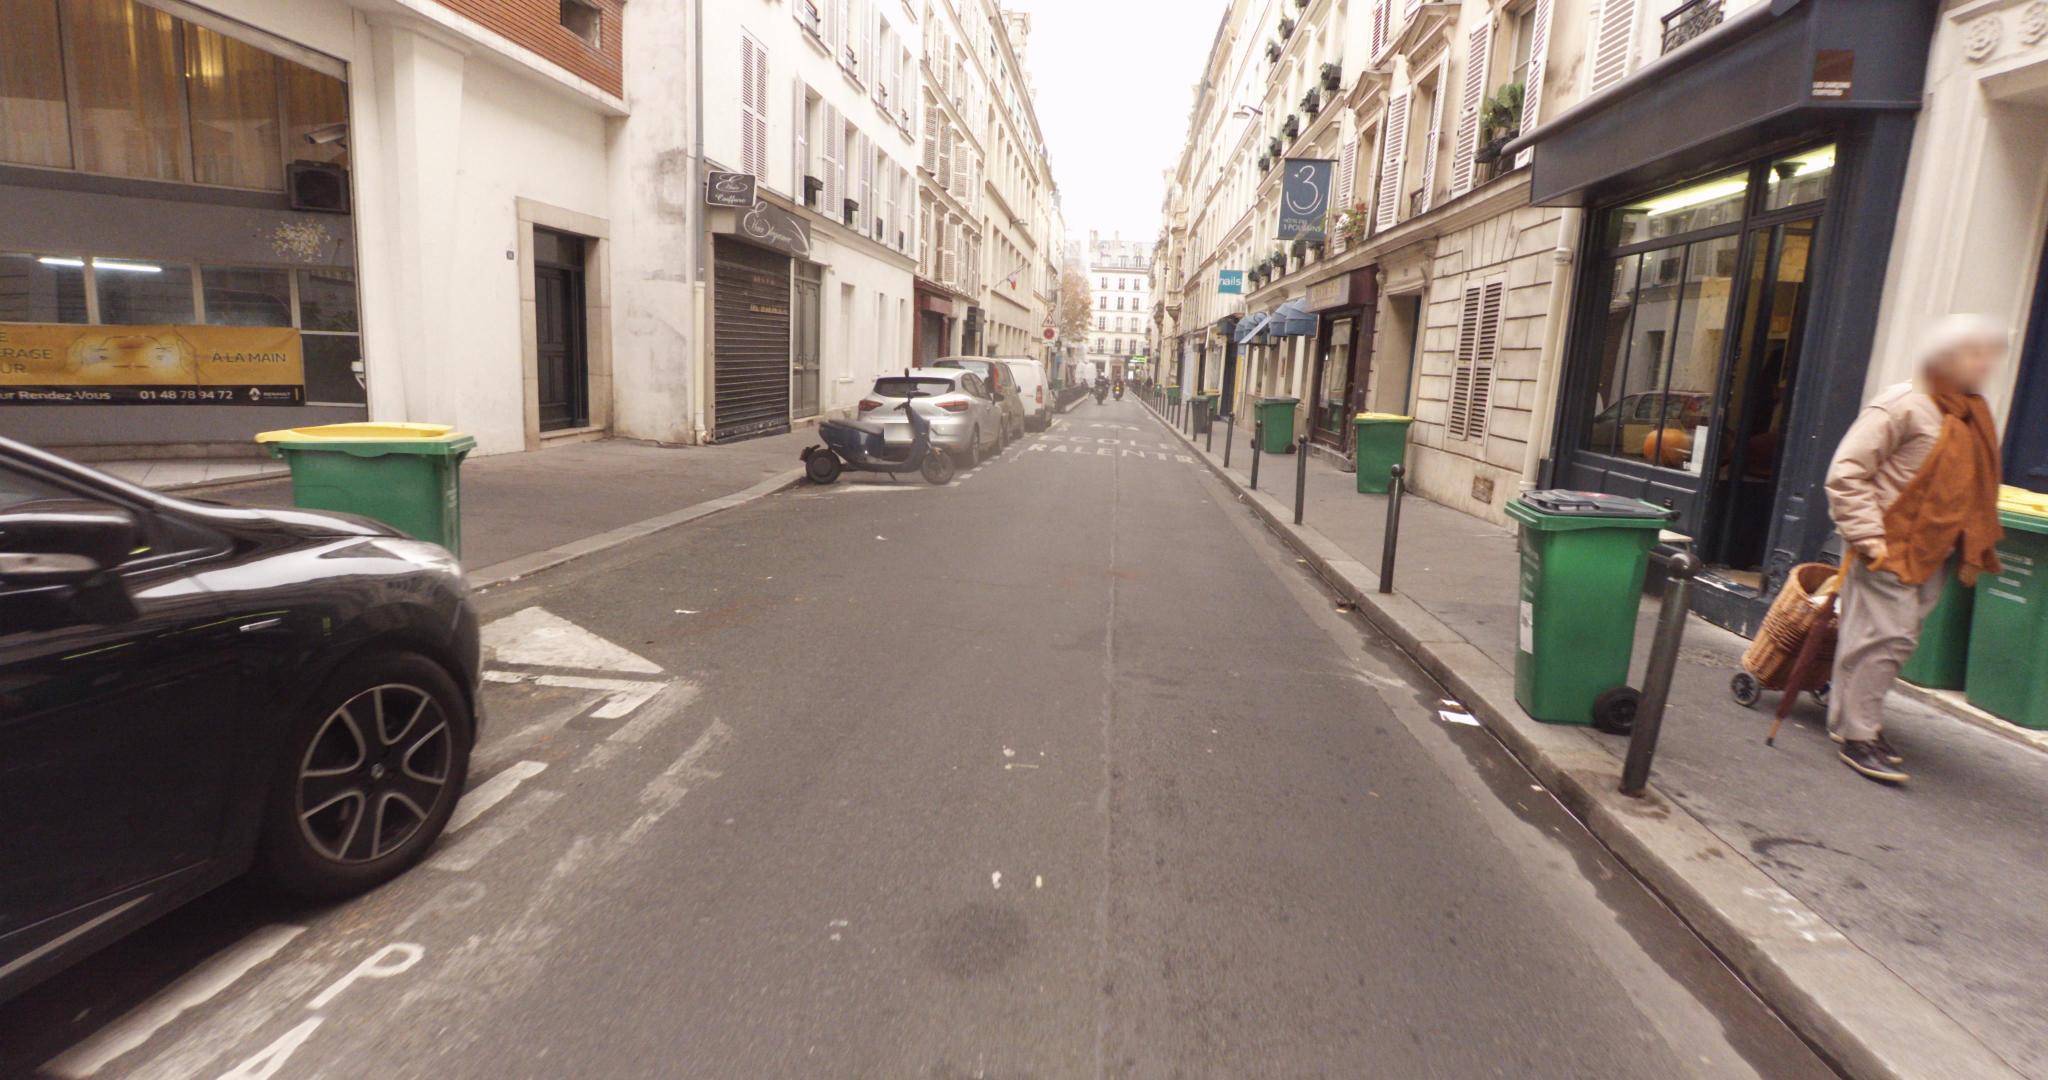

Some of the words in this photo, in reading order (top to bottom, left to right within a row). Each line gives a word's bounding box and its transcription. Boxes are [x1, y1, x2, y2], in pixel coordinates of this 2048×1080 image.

[1219, 276, 1242, 286] nails
[247, 351, 286, 363] MAIN
[18, 390, 112, 400] Rendez-Vous
[139, 390, 157, 400] 01
[159, 390, 177, 400] 48
[179, 390, 197, 400] 78
[198, 390, 215, 400] 94
[217, 390, 234, 400] 72
